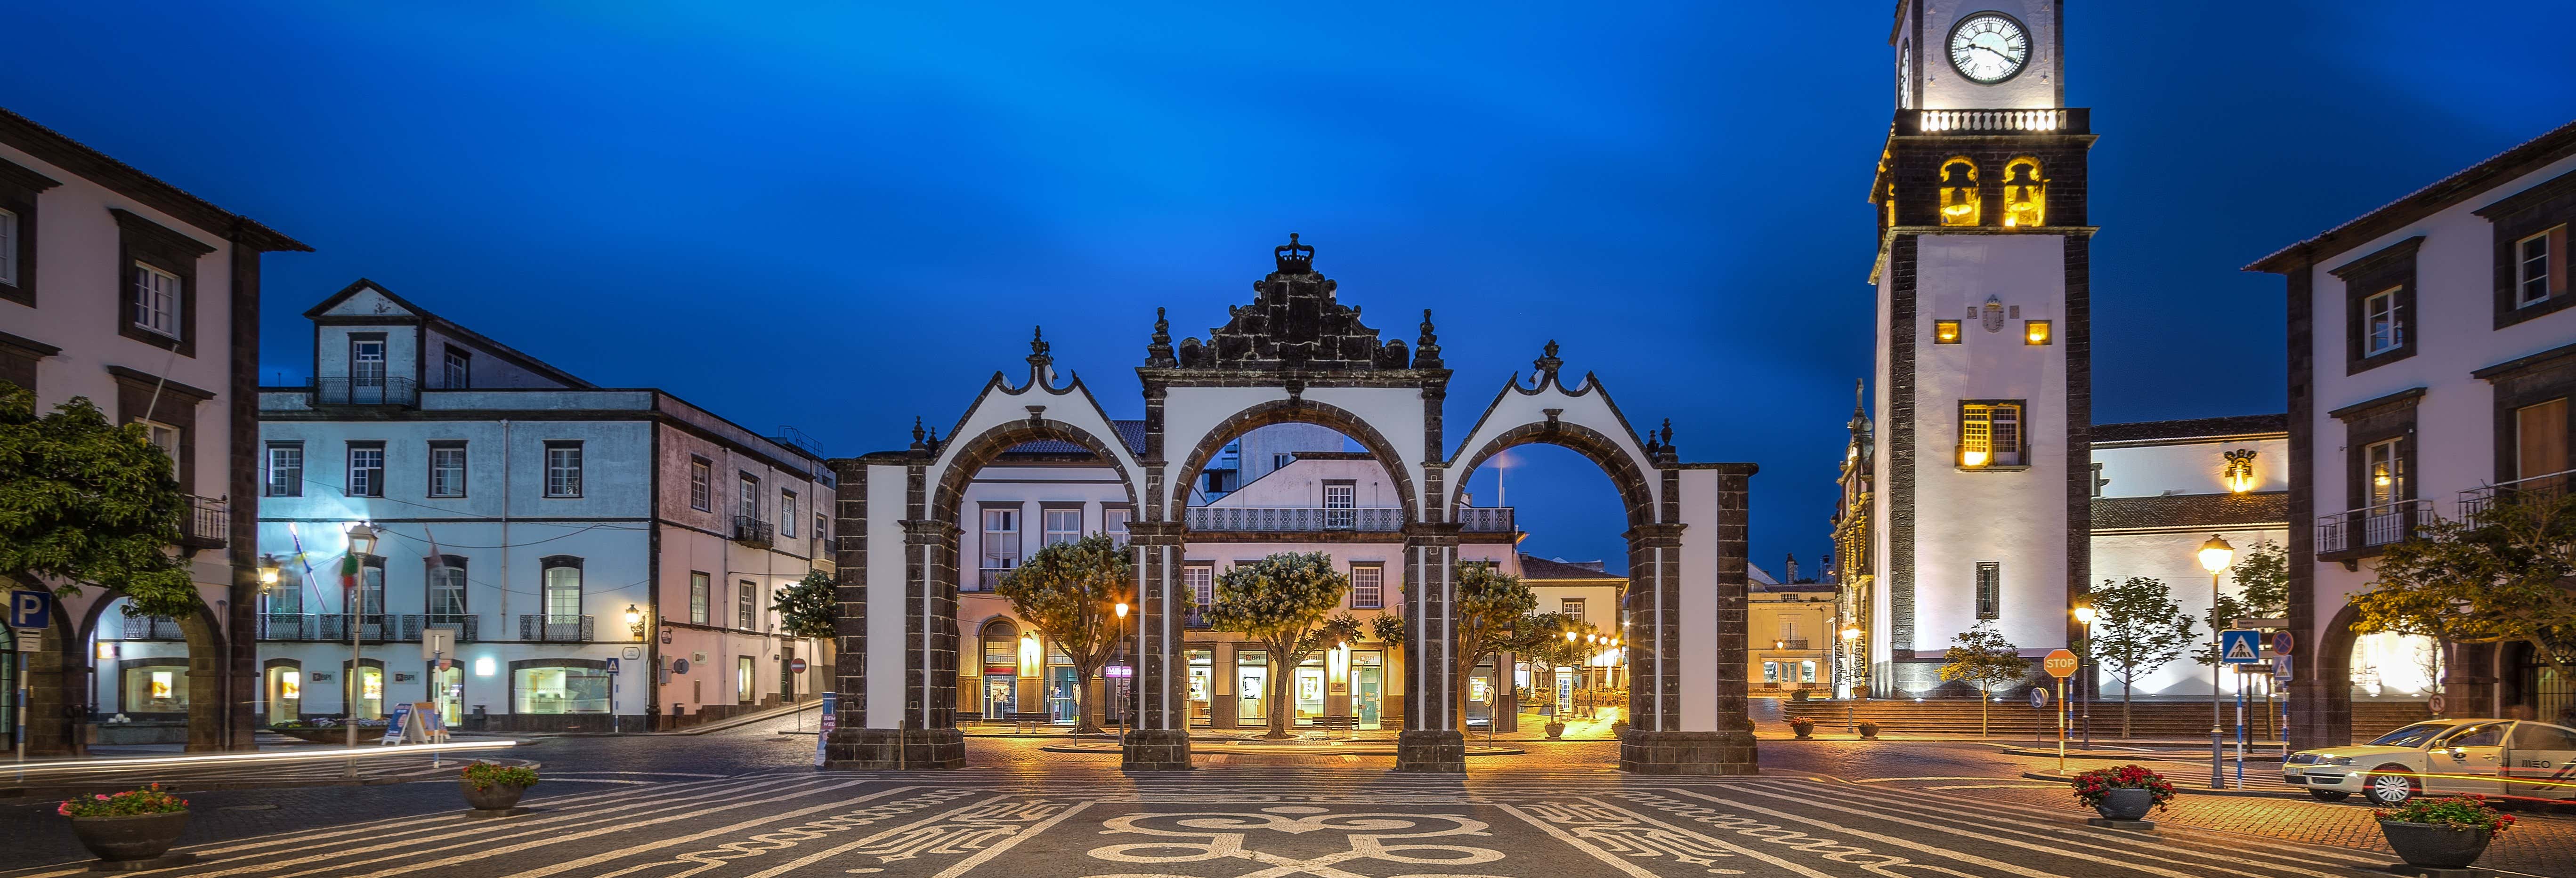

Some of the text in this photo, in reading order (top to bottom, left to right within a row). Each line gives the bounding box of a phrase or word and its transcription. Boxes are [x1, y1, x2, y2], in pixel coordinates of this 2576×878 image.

[19, 594, 41, 624] P
[2046, 659, 2075, 668] STOP
[2522, 759, 2551, 768] MEO
